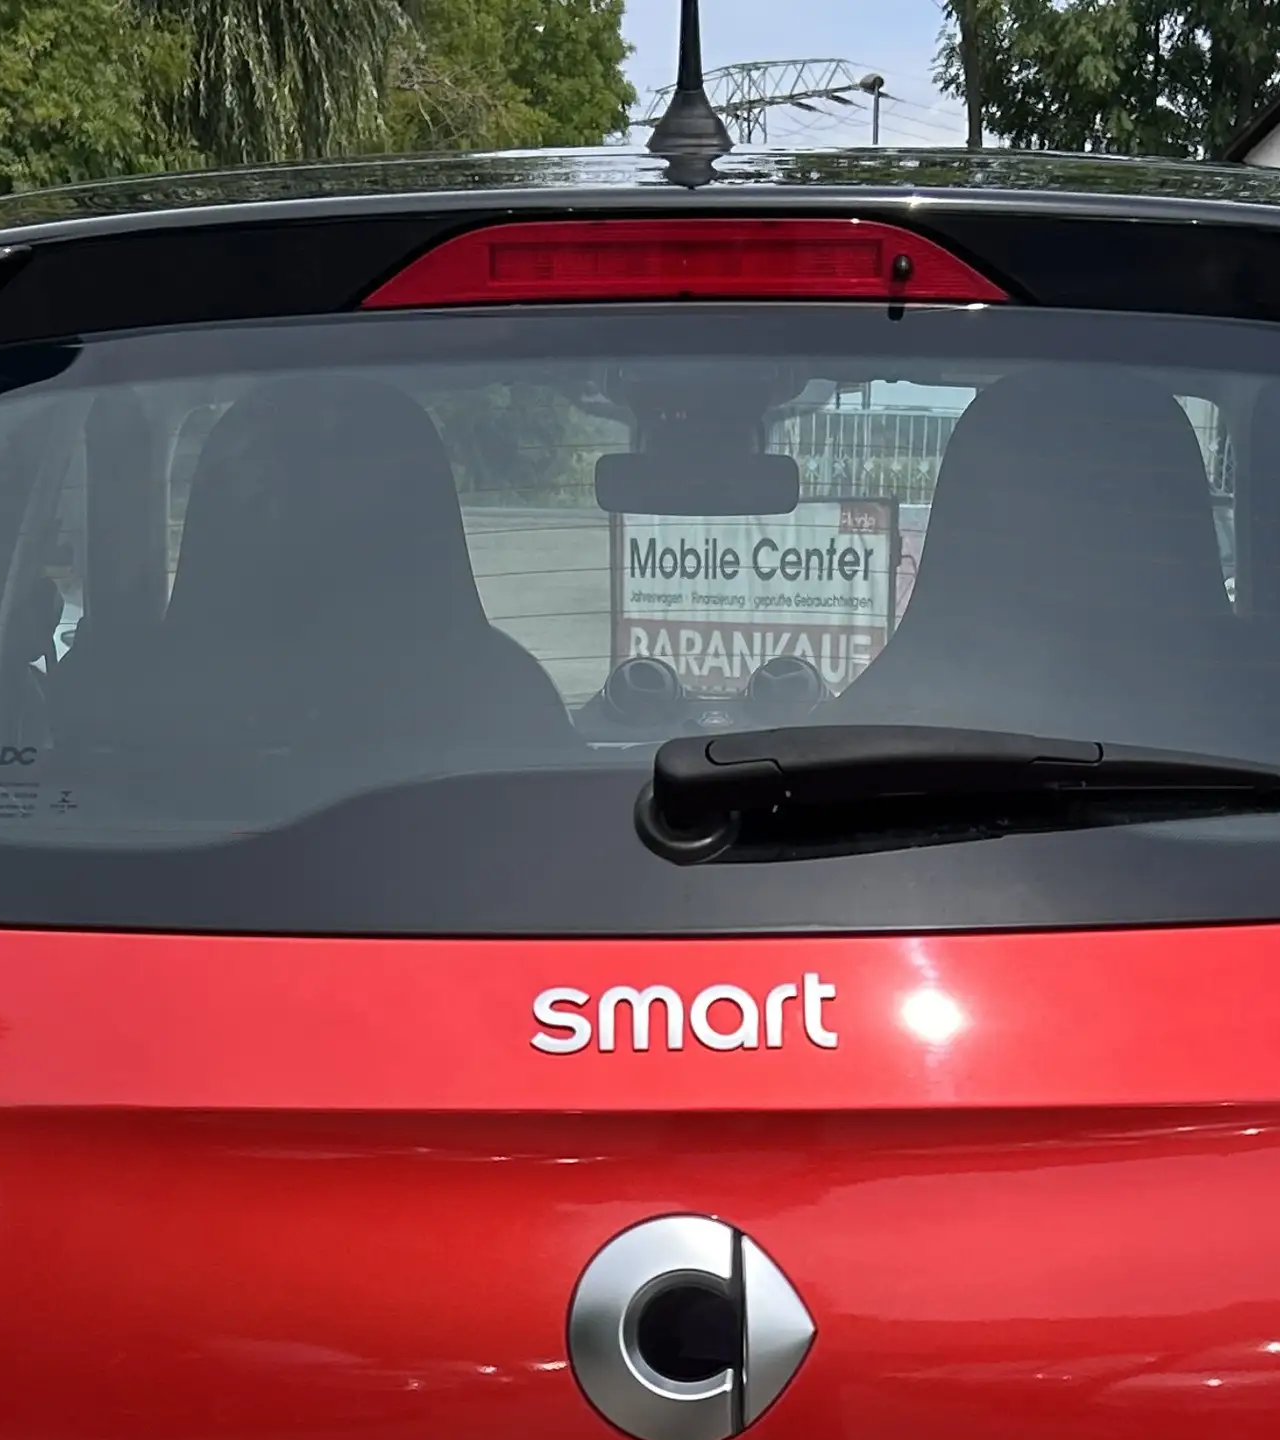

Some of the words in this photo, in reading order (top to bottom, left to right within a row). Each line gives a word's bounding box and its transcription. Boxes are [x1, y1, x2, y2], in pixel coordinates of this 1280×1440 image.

[629, 537, 740, 581] Mobile
[752, 537, 874, 581] Center
[530, 972, 839, 1055] smart
